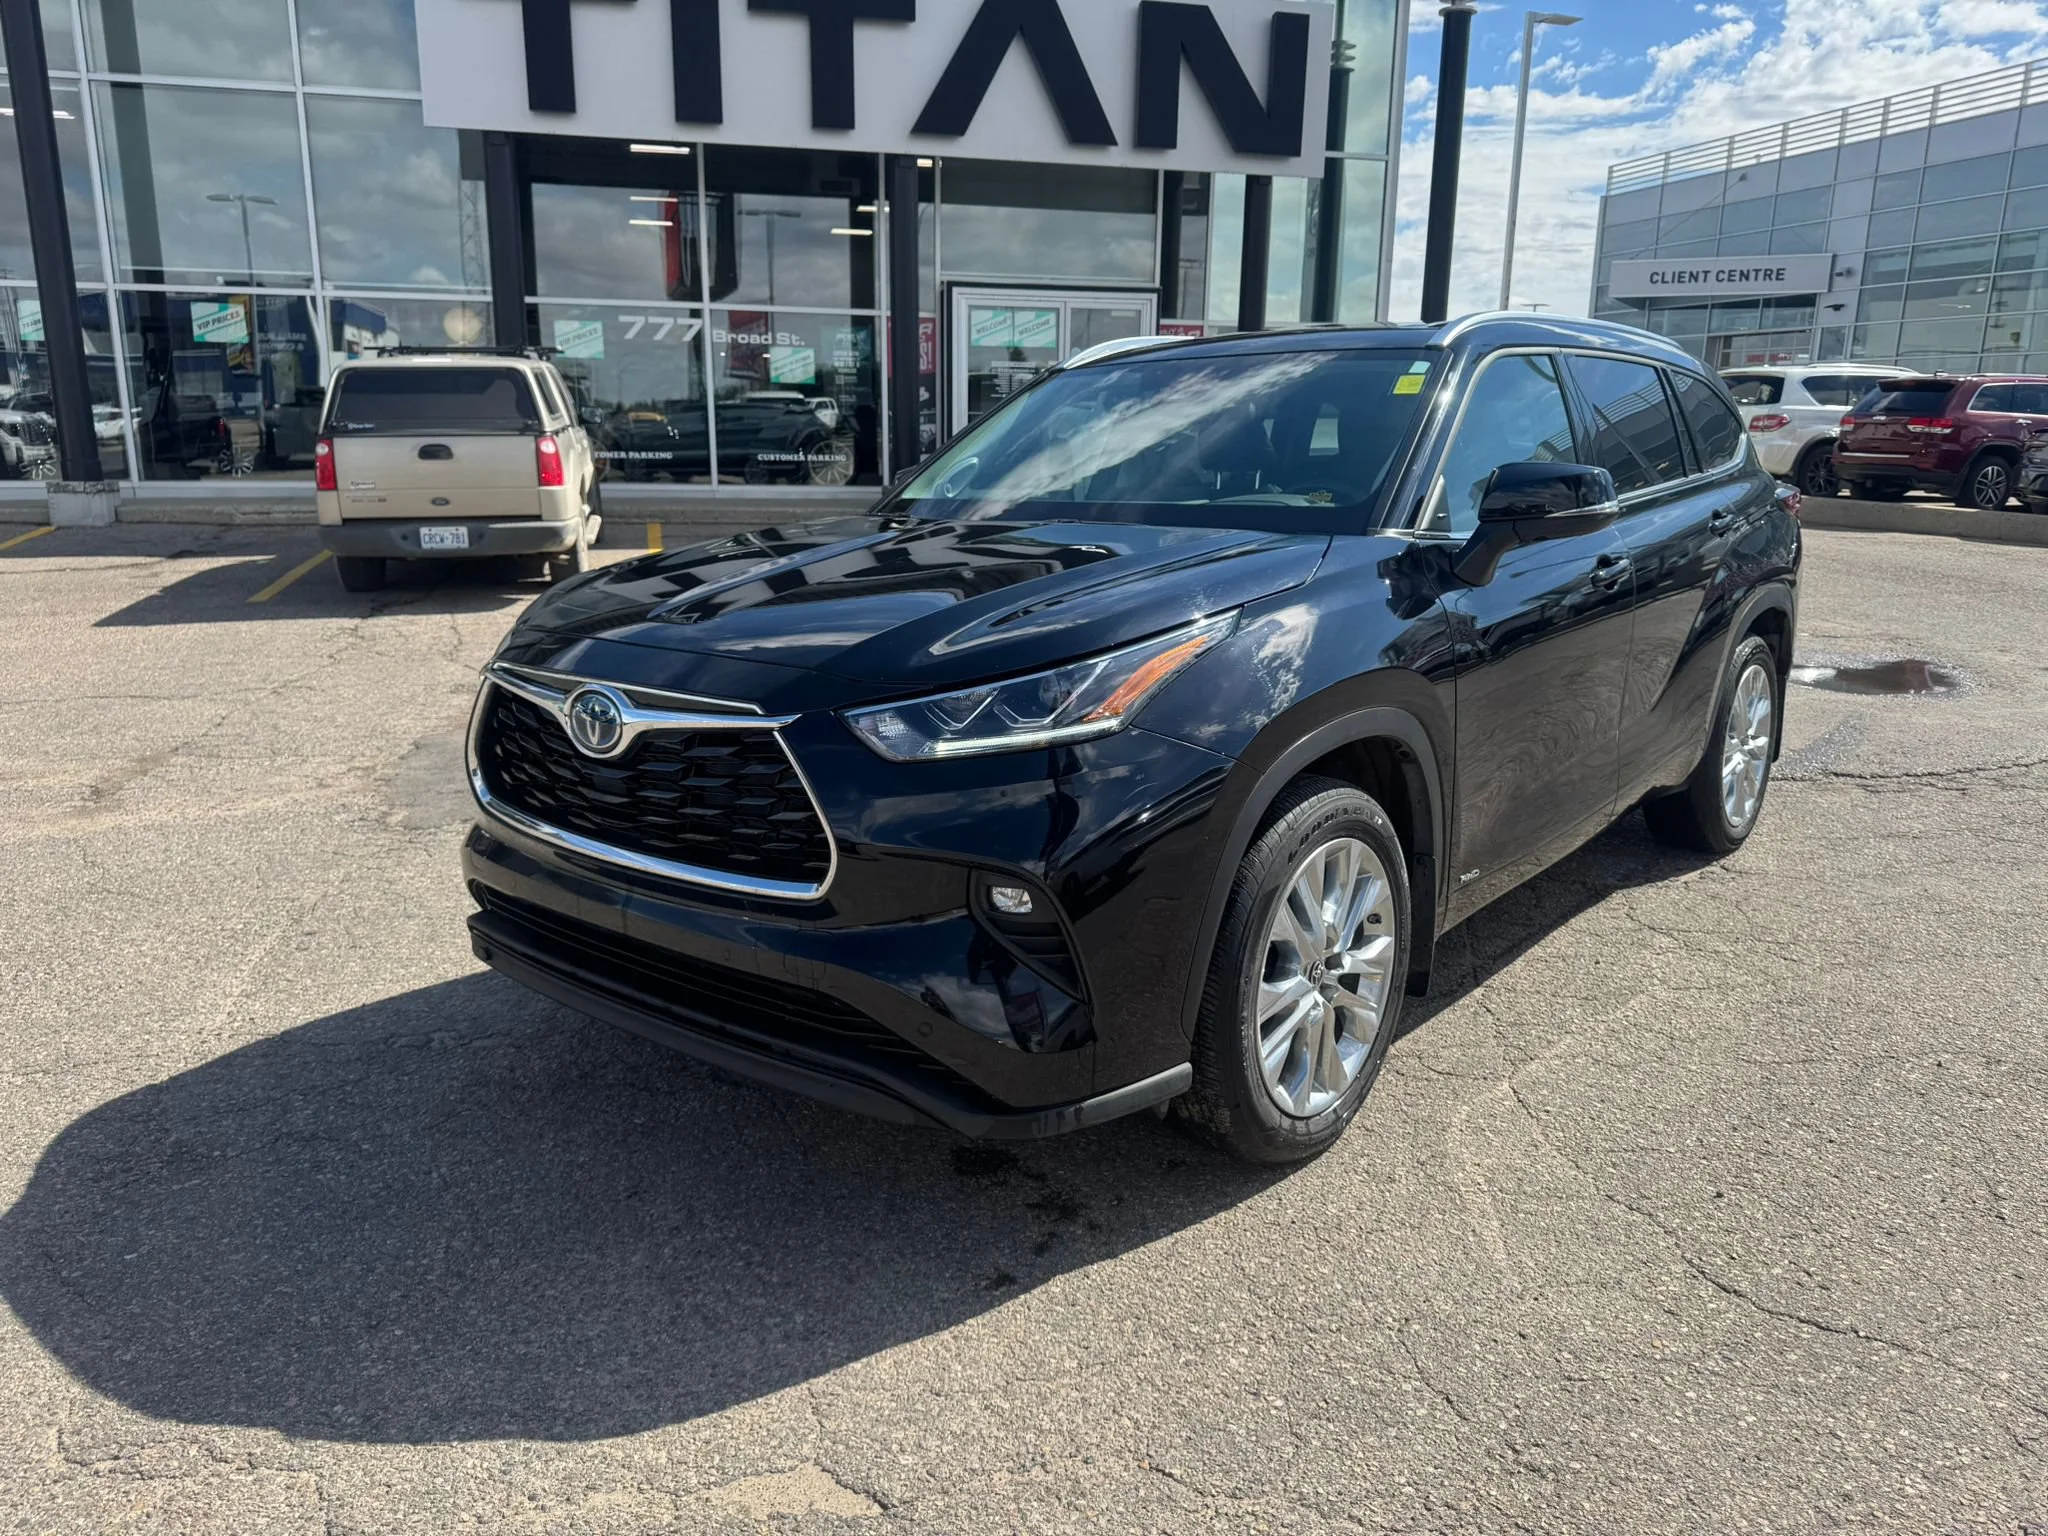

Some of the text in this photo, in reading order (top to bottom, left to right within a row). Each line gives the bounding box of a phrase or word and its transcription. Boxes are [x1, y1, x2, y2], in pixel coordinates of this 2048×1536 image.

[520, 0, 1310, 157] TITAN
[1649, 268, 1787, 284] CLIENT CENTRE
[197, 310, 241, 331] VIP PRICES
[618, 315, 805, 345] 777 Broad St.
[1018, 317, 1051, 337] WELCOME
[594, 450, 673, 460] TOMER PARKING
[757, 453, 847, 461] CUSTOMER PARKING
